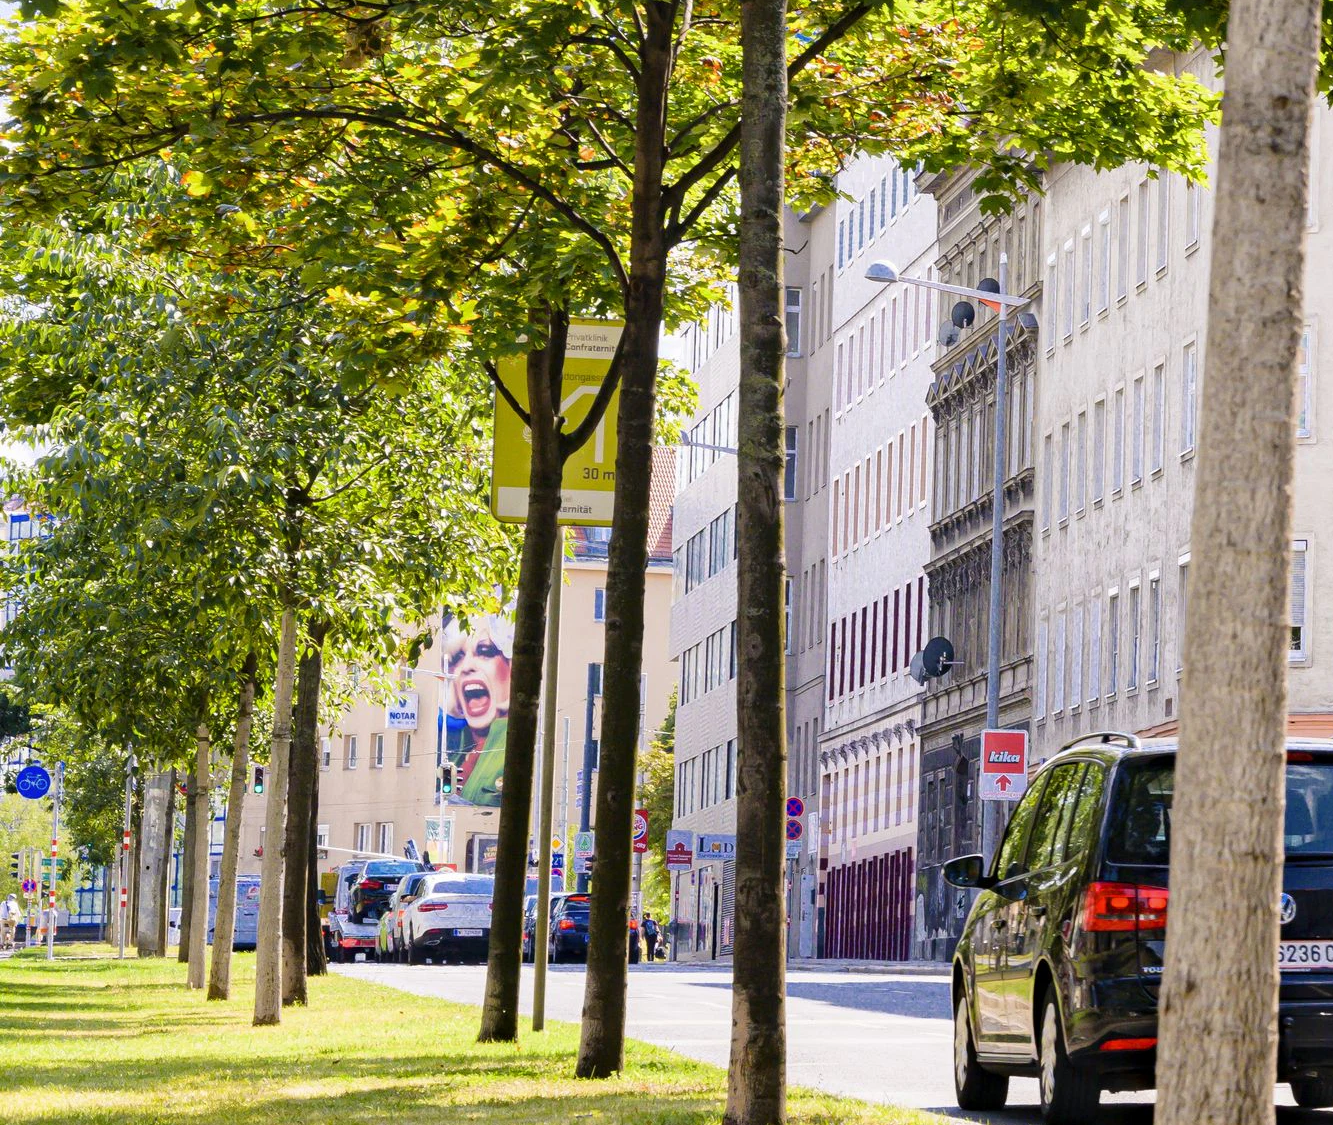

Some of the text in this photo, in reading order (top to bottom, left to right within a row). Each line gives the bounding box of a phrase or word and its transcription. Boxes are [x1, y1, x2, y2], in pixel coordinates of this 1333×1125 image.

[565, 343, 616, 353] Confraternit
[583, 467, 615, 480] 30 m
[389, 712, 415, 720] NOTAR
[988, 751, 1020, 763] kika
